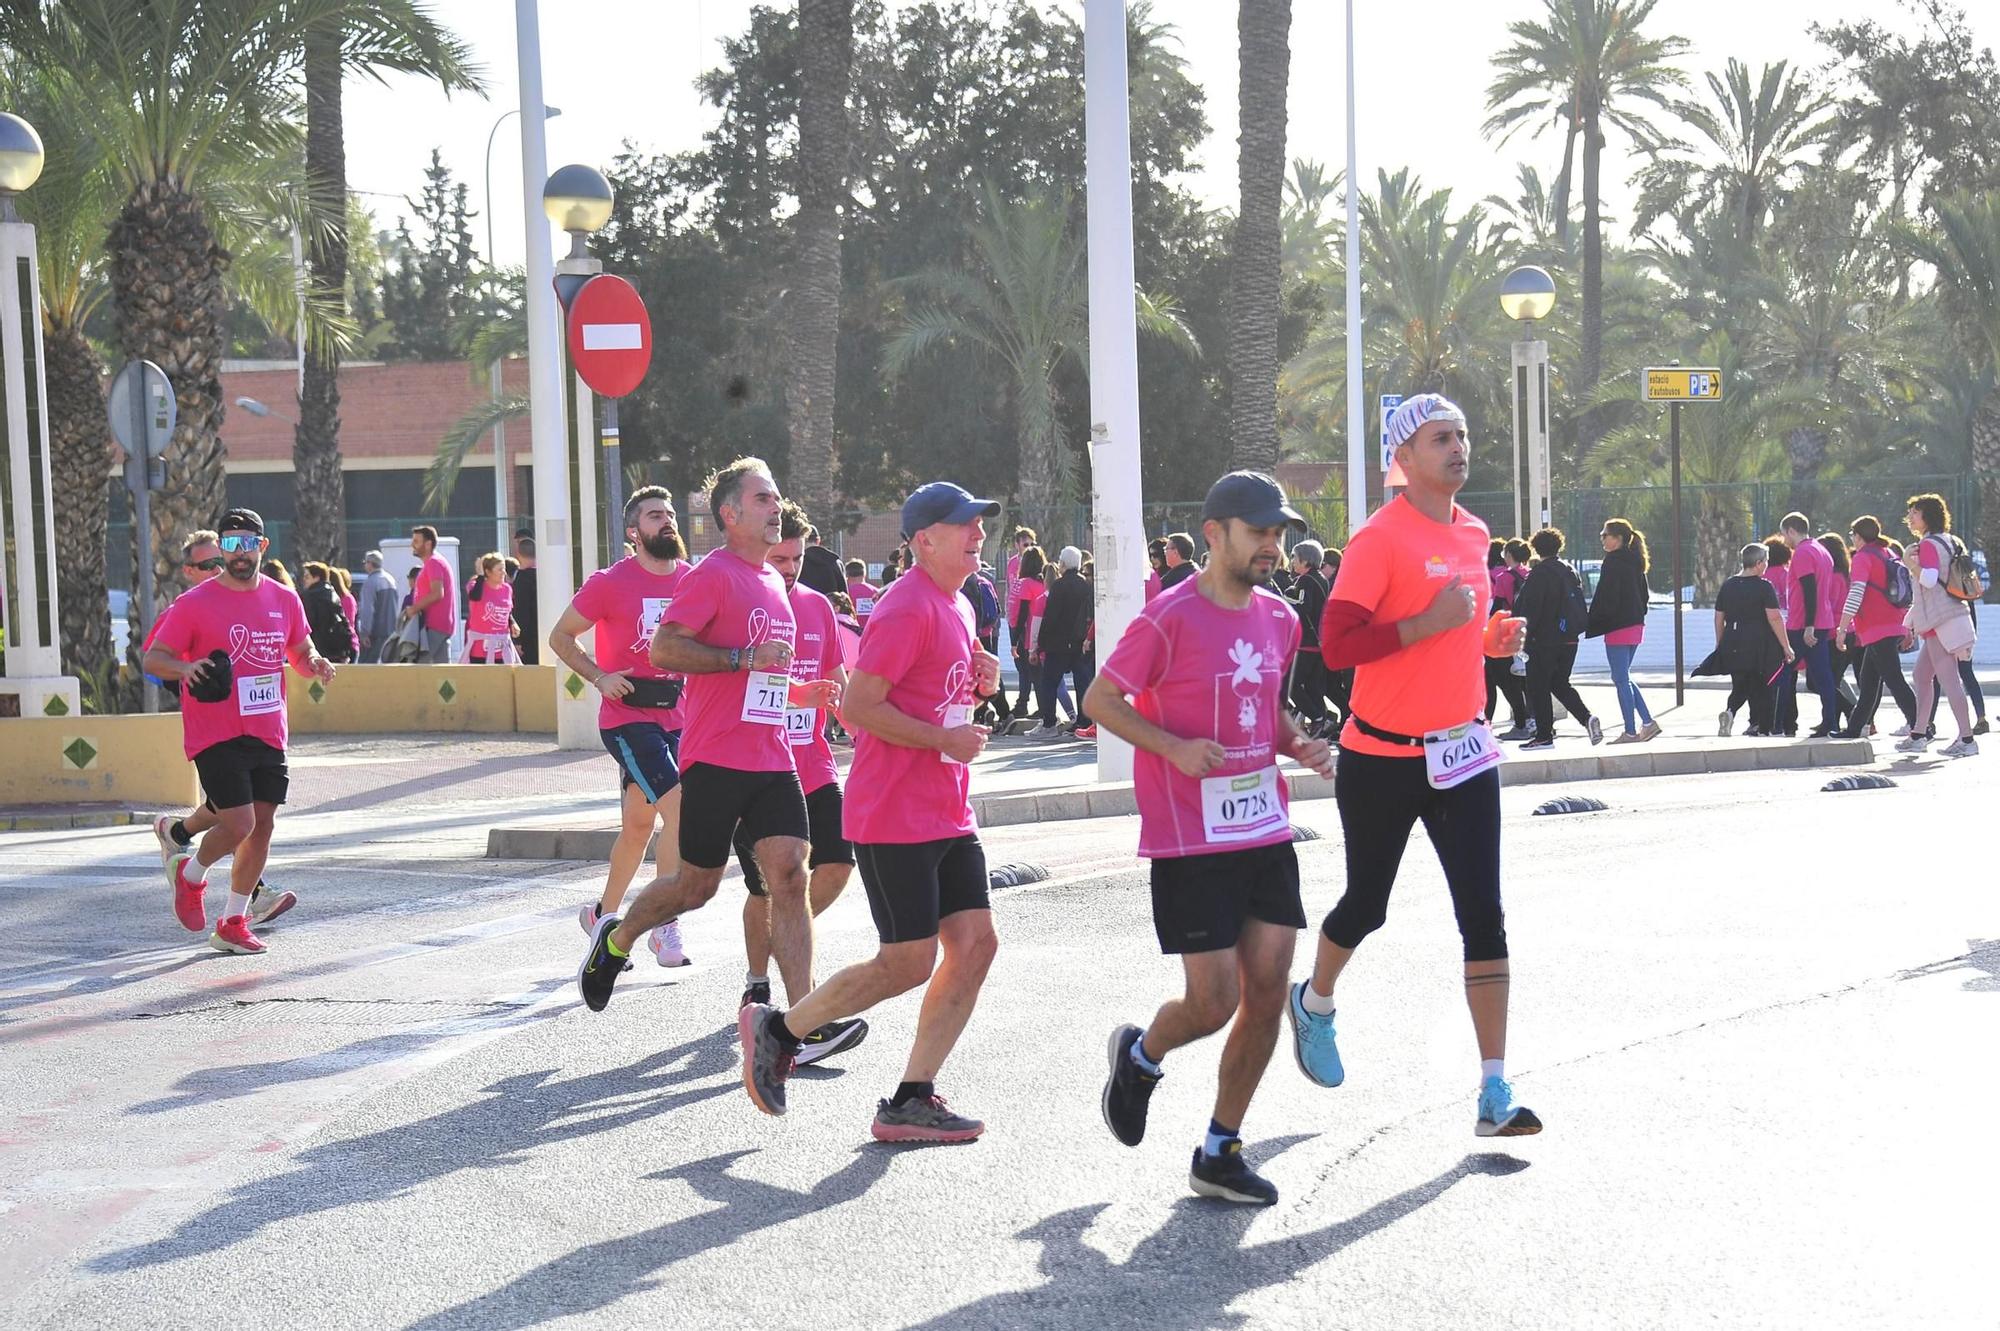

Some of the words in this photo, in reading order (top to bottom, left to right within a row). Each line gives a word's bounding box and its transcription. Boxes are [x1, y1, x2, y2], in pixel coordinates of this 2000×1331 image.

[1649, 375, 1669, 384] estació
[1691, 376, 1698, 395] P
[249, 686, 275, 702] 0461
[1222, 791, 1267, 820] 0728
